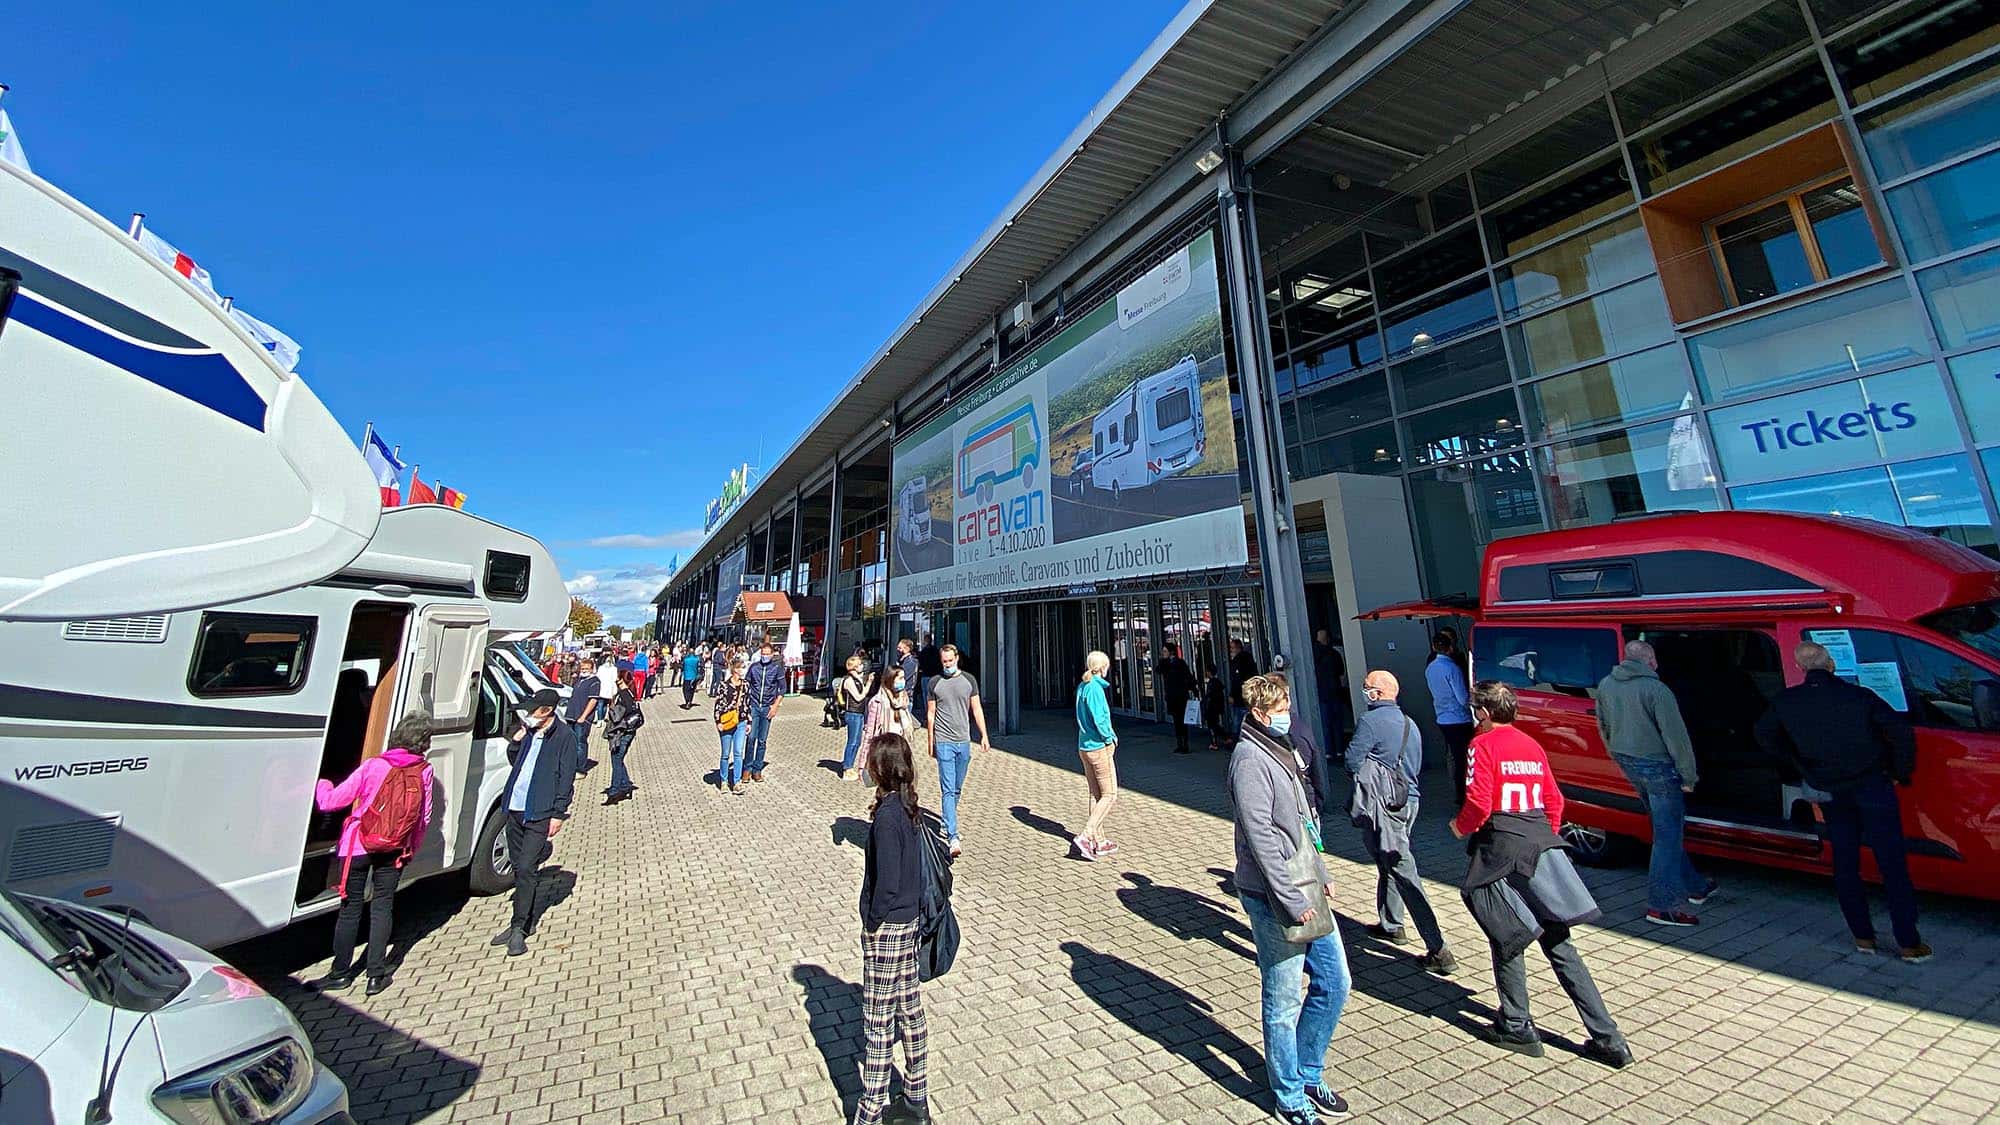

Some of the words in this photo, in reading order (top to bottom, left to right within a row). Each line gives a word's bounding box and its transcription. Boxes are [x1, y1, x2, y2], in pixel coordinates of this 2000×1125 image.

[996, 358, 1038, 392] caravanlive.de
[1741, 402, 1917, 453] Tickets
[958, 489, 1044, 545] caravan
[906, 577, 953, 598] Fachausstellung
[955, 573, 966, 591] für
[968, 564, 1018, 590] Reisemobile,
[1021, 560, 1069, 582] Caravans
[1074, 548, 1100, 575] und
[1106, 538, 1173, 571] Zubehör
[15, 757, 149, 781] WEINSBERG
